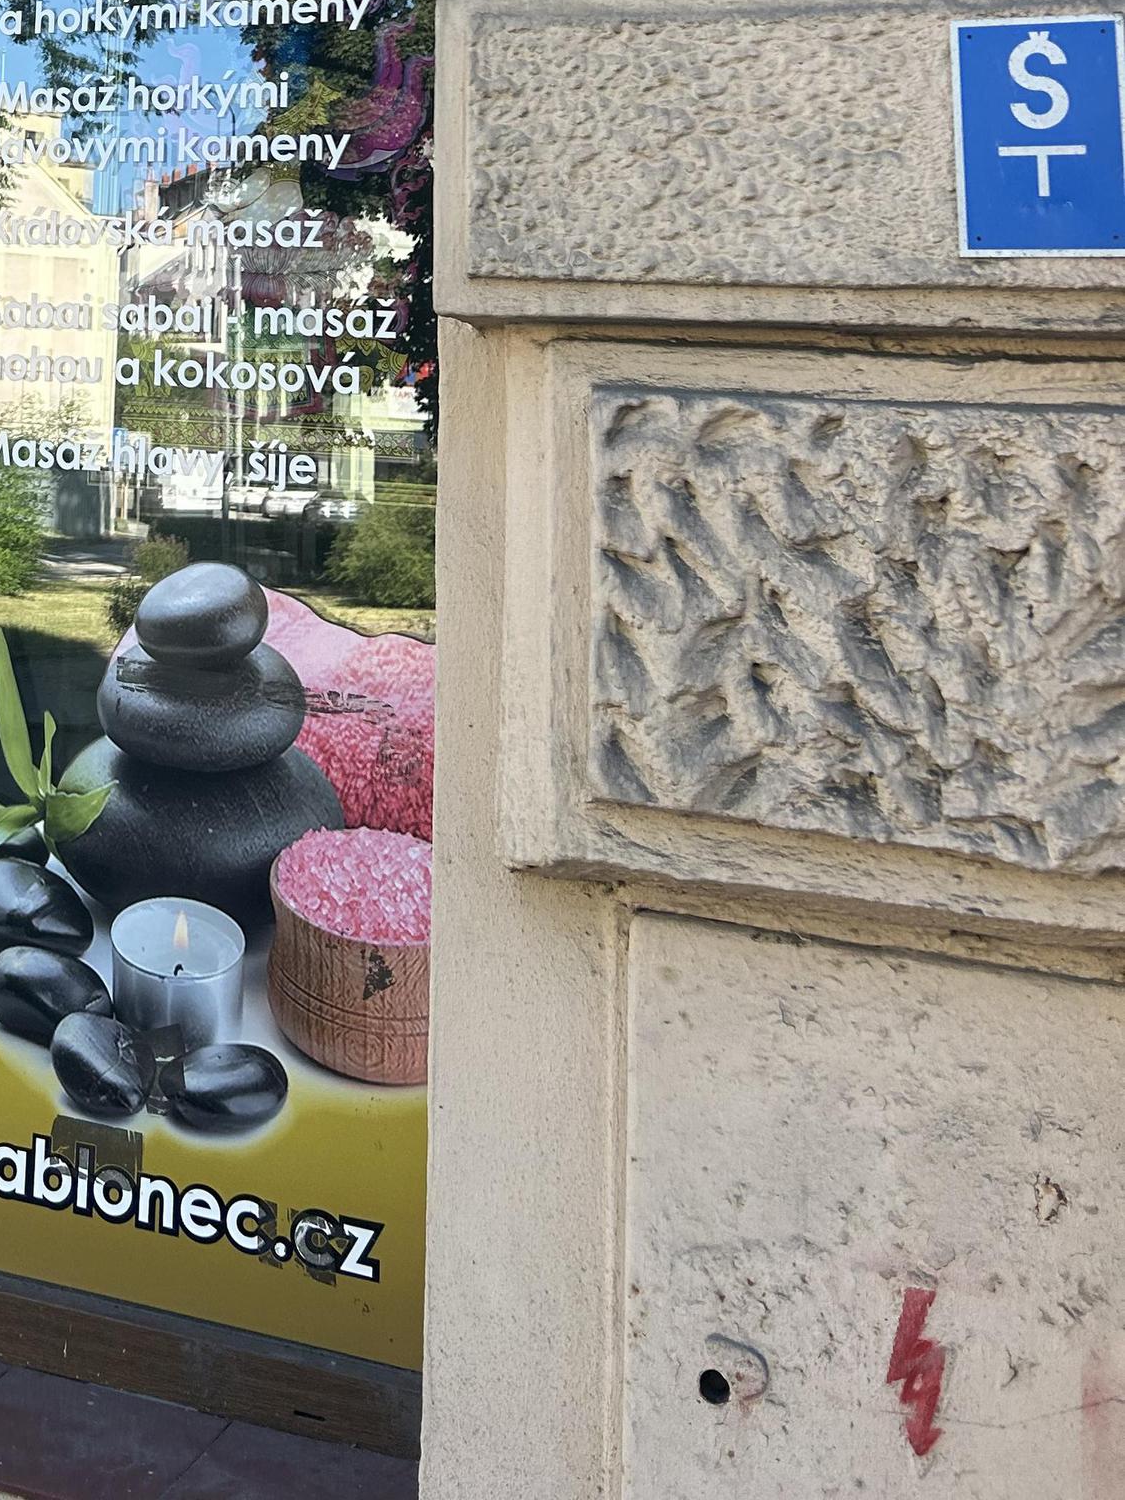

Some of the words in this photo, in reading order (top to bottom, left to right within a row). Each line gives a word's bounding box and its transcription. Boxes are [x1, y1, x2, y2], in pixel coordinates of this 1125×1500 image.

[0, 9, 23, 36] a
[128, 71, 289, 118] horkými
[1007, 31, 1071, 130] Š
[178, 124, 352, 169] kameny
[187, 206, 325, 250] masáž
[101, 294, 213, 334] sabai
[253, 296, 399, 340] masáž
[114, 358, 141, 387] a
[153, 351, 362, 396] kokosová
[247, 437, 319, 493] šíje
